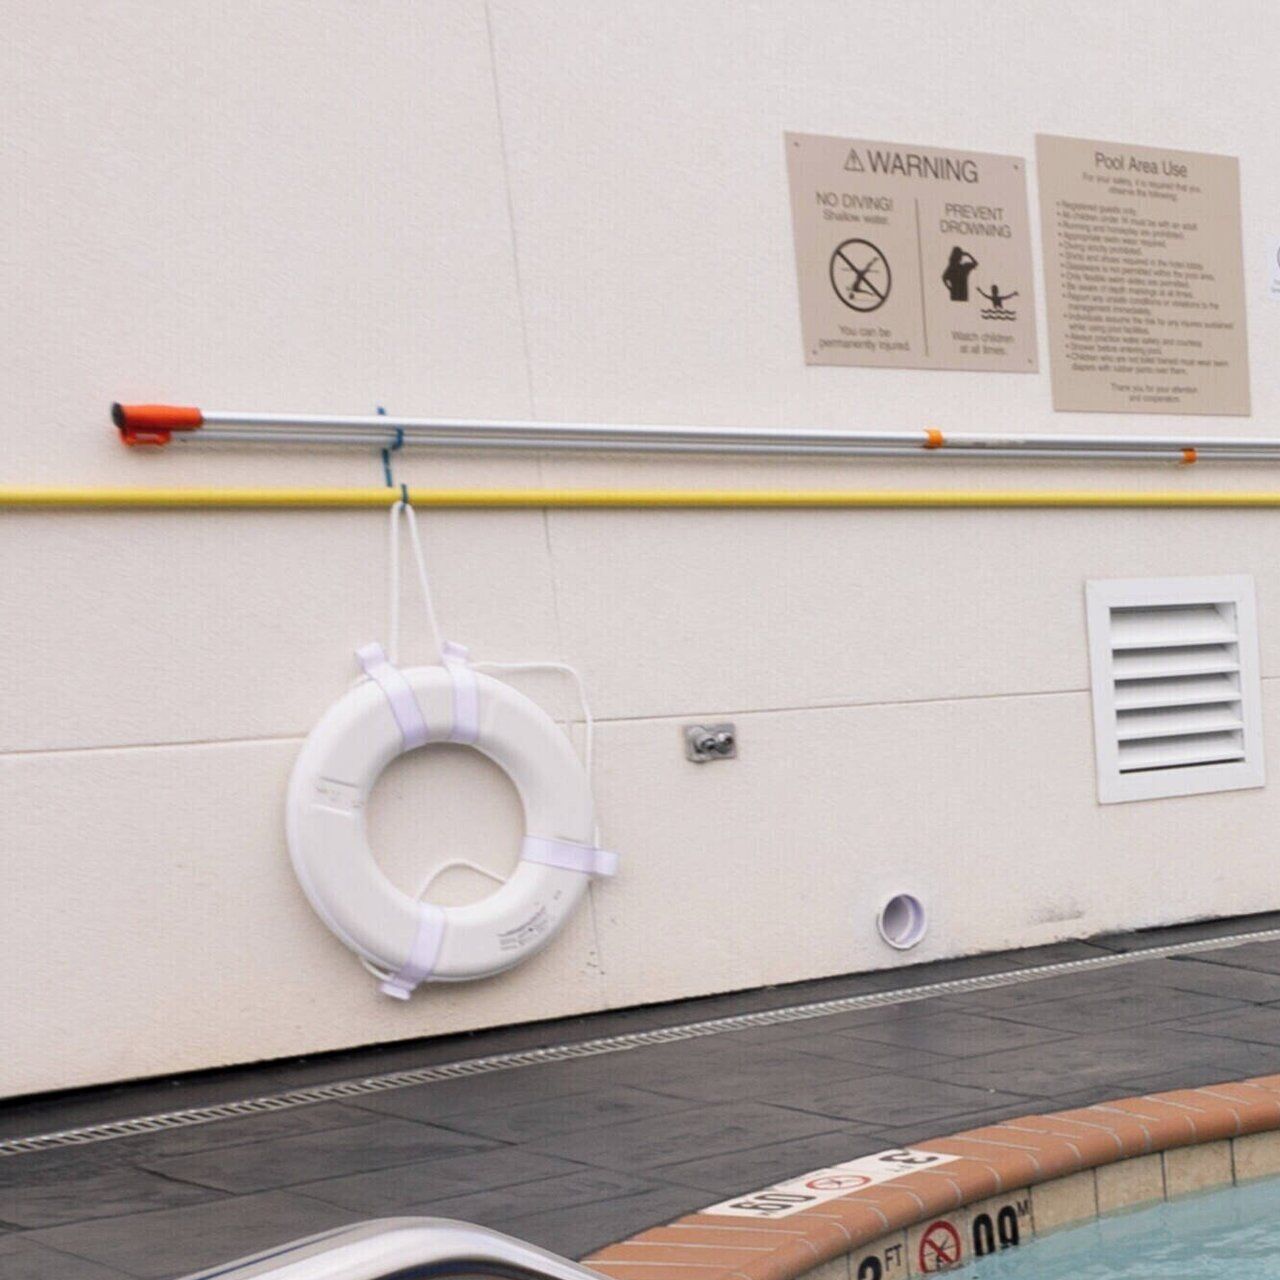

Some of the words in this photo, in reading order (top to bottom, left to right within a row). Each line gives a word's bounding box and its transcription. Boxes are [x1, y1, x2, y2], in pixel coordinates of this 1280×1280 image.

[867, 149, 979, 183] WARNING
[1094, 152, 1124, 170] Pool
[1128, 156, 1158, 174] Area
[1161, 160, 1187, 178] Use
[816, 192, 839, 206] NO
[844, 194, 893, 211] DIVING!
[945, 203, 1004, 220] PREVENT
[940, 220, 1011, 238] DROWNING
[1016, 1200, 1029, 1217] M
[884, 1244, 902, 1271] FT
